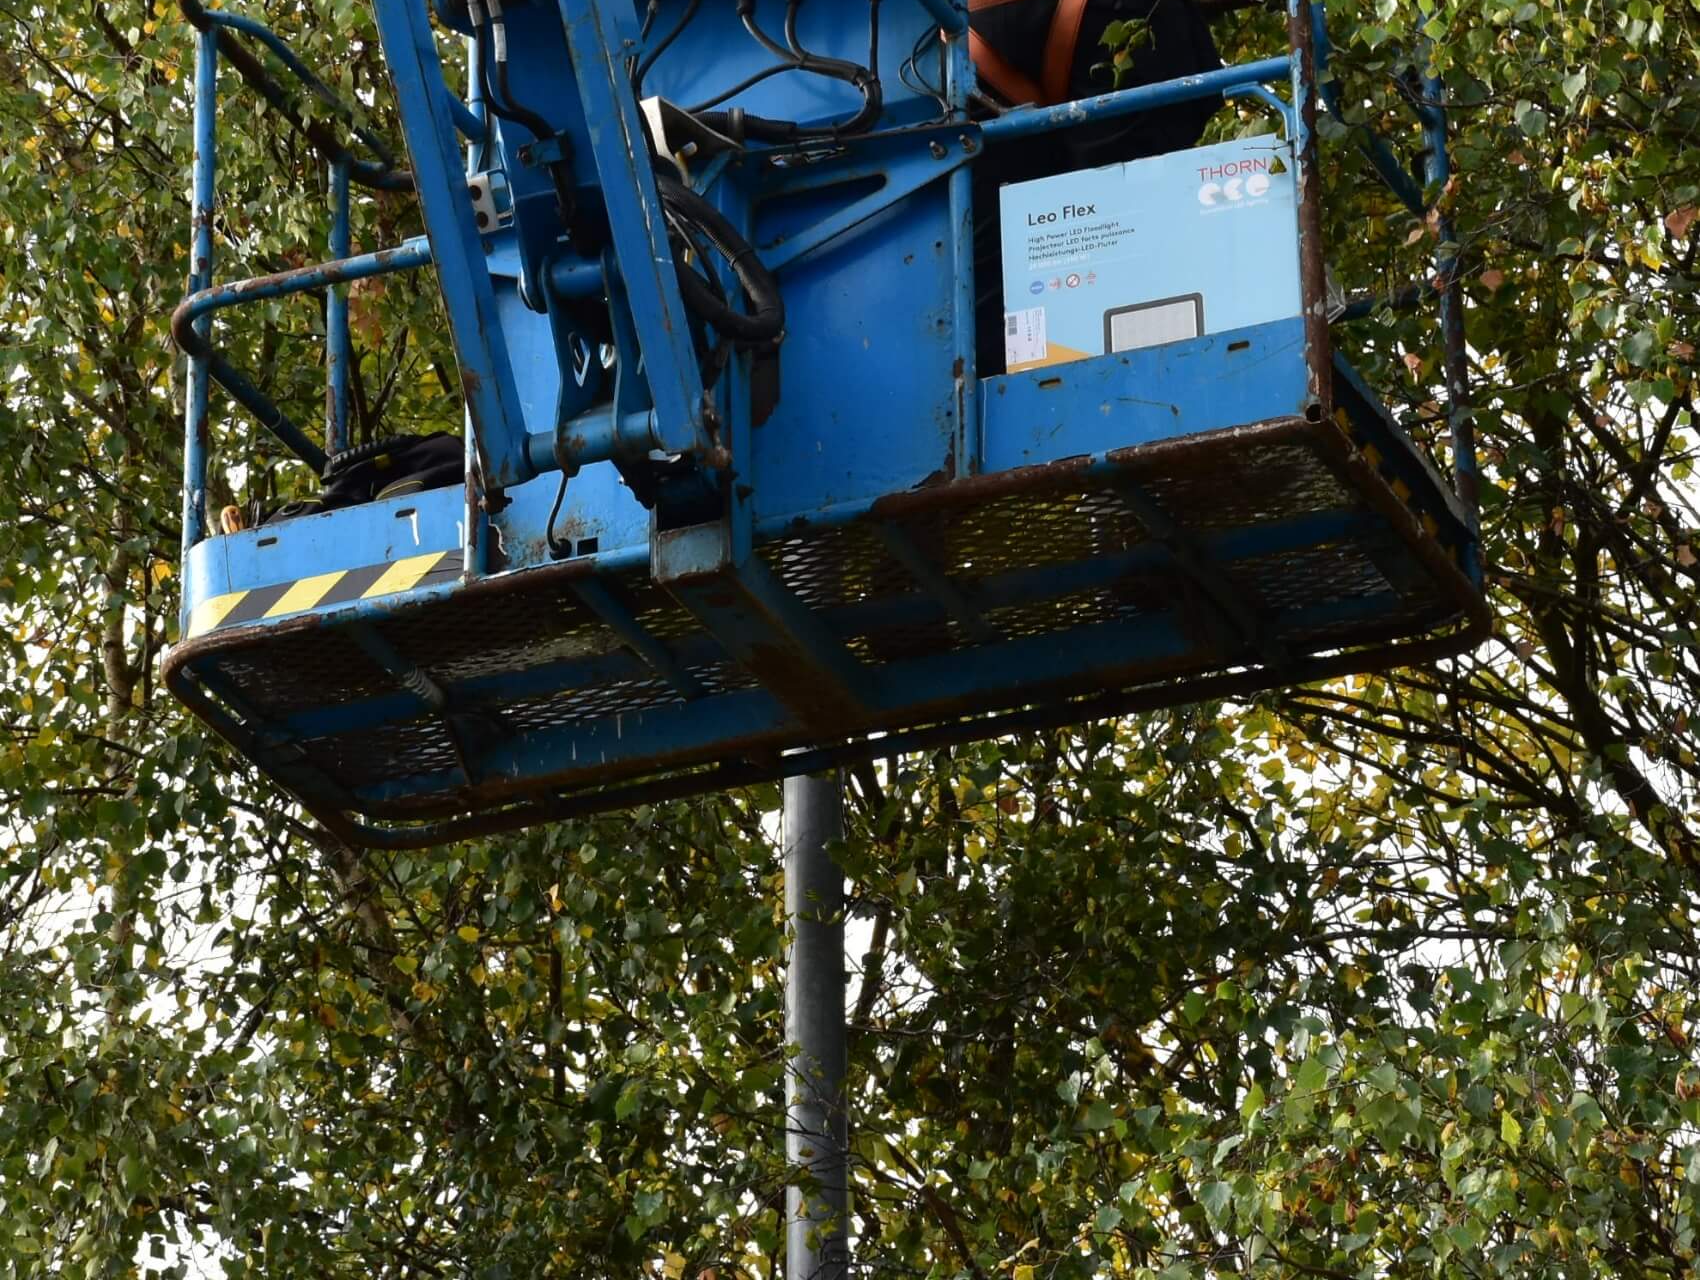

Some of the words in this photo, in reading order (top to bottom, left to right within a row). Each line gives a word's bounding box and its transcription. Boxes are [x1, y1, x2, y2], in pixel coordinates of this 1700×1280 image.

[1197, 157, 1267, 181] THORN
[1027, 213, 1057, 226] Leo
[1063, 204, 1096, 220] Flex
[1027, 235, 1046, 245] High
[1046, 231, 1069, 241] Power
[1069, 228, 1083, 237] LED
[1027, 241, 1065, 253] Projecteur
[1065, 237, 1080, 246] LED
